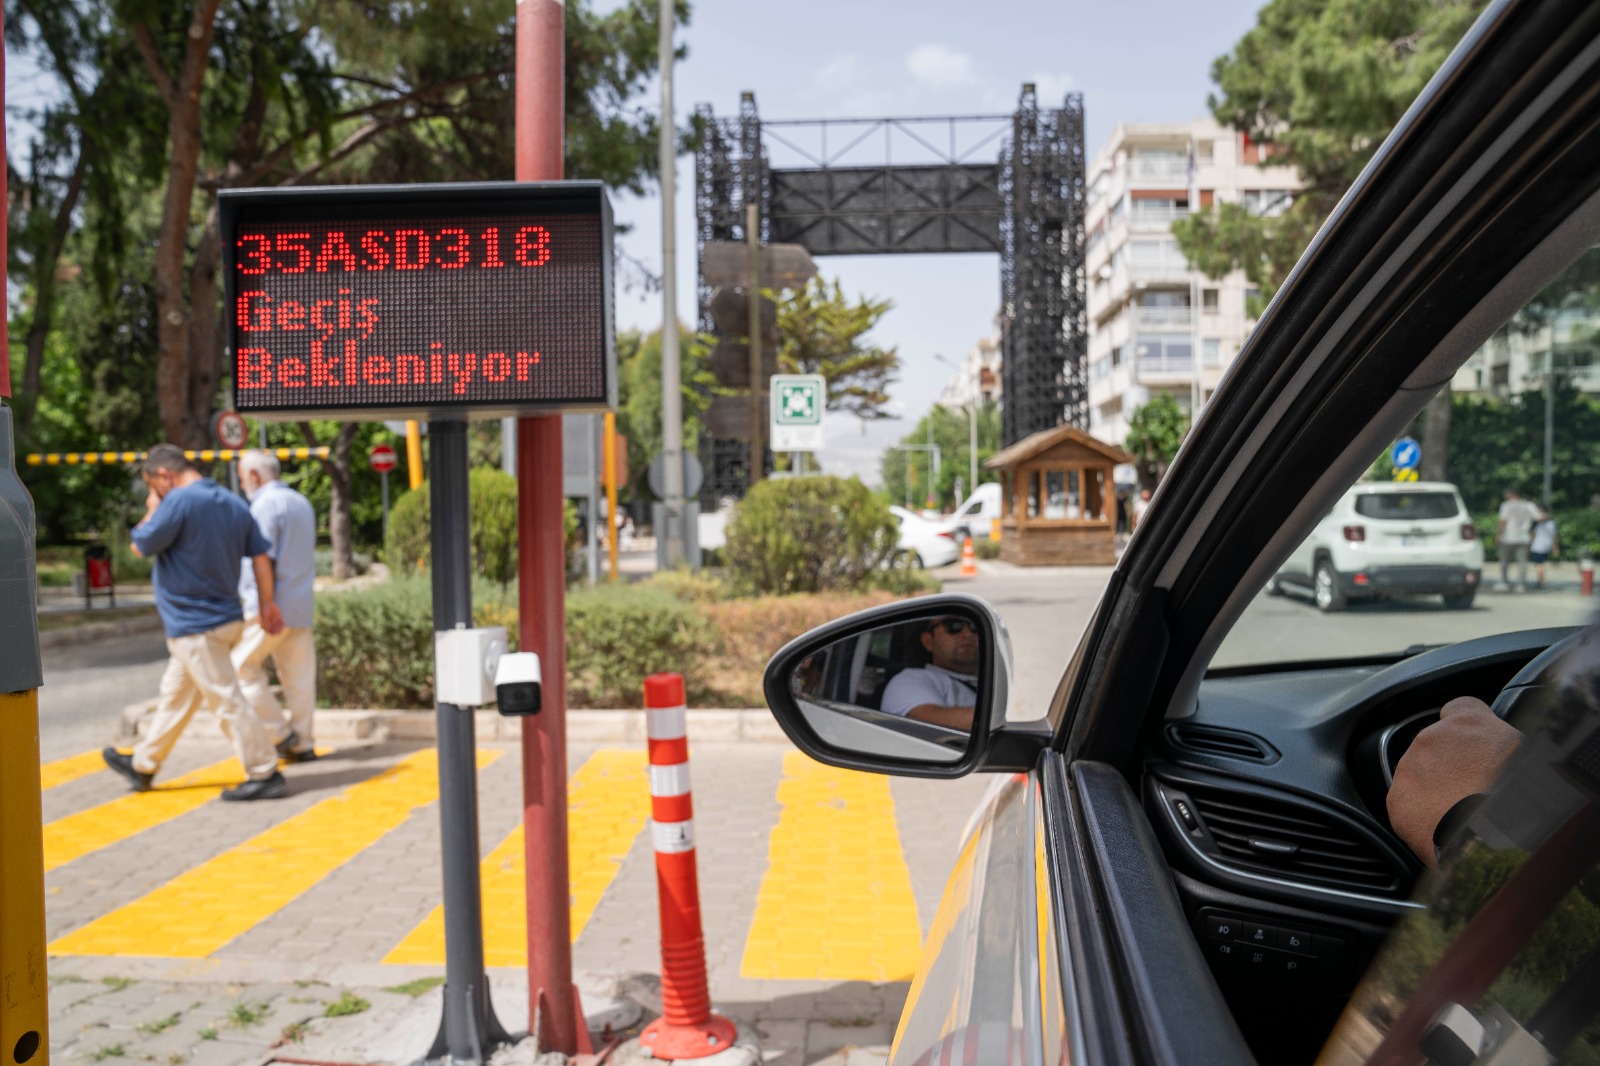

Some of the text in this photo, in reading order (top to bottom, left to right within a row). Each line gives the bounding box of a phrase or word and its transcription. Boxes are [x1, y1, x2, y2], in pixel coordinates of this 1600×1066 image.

[237, 226, 550, 274] 35ASD318
[237, 288, 379, 340] Geçiş
[237, 339, 540, 394] Bekleniyor
